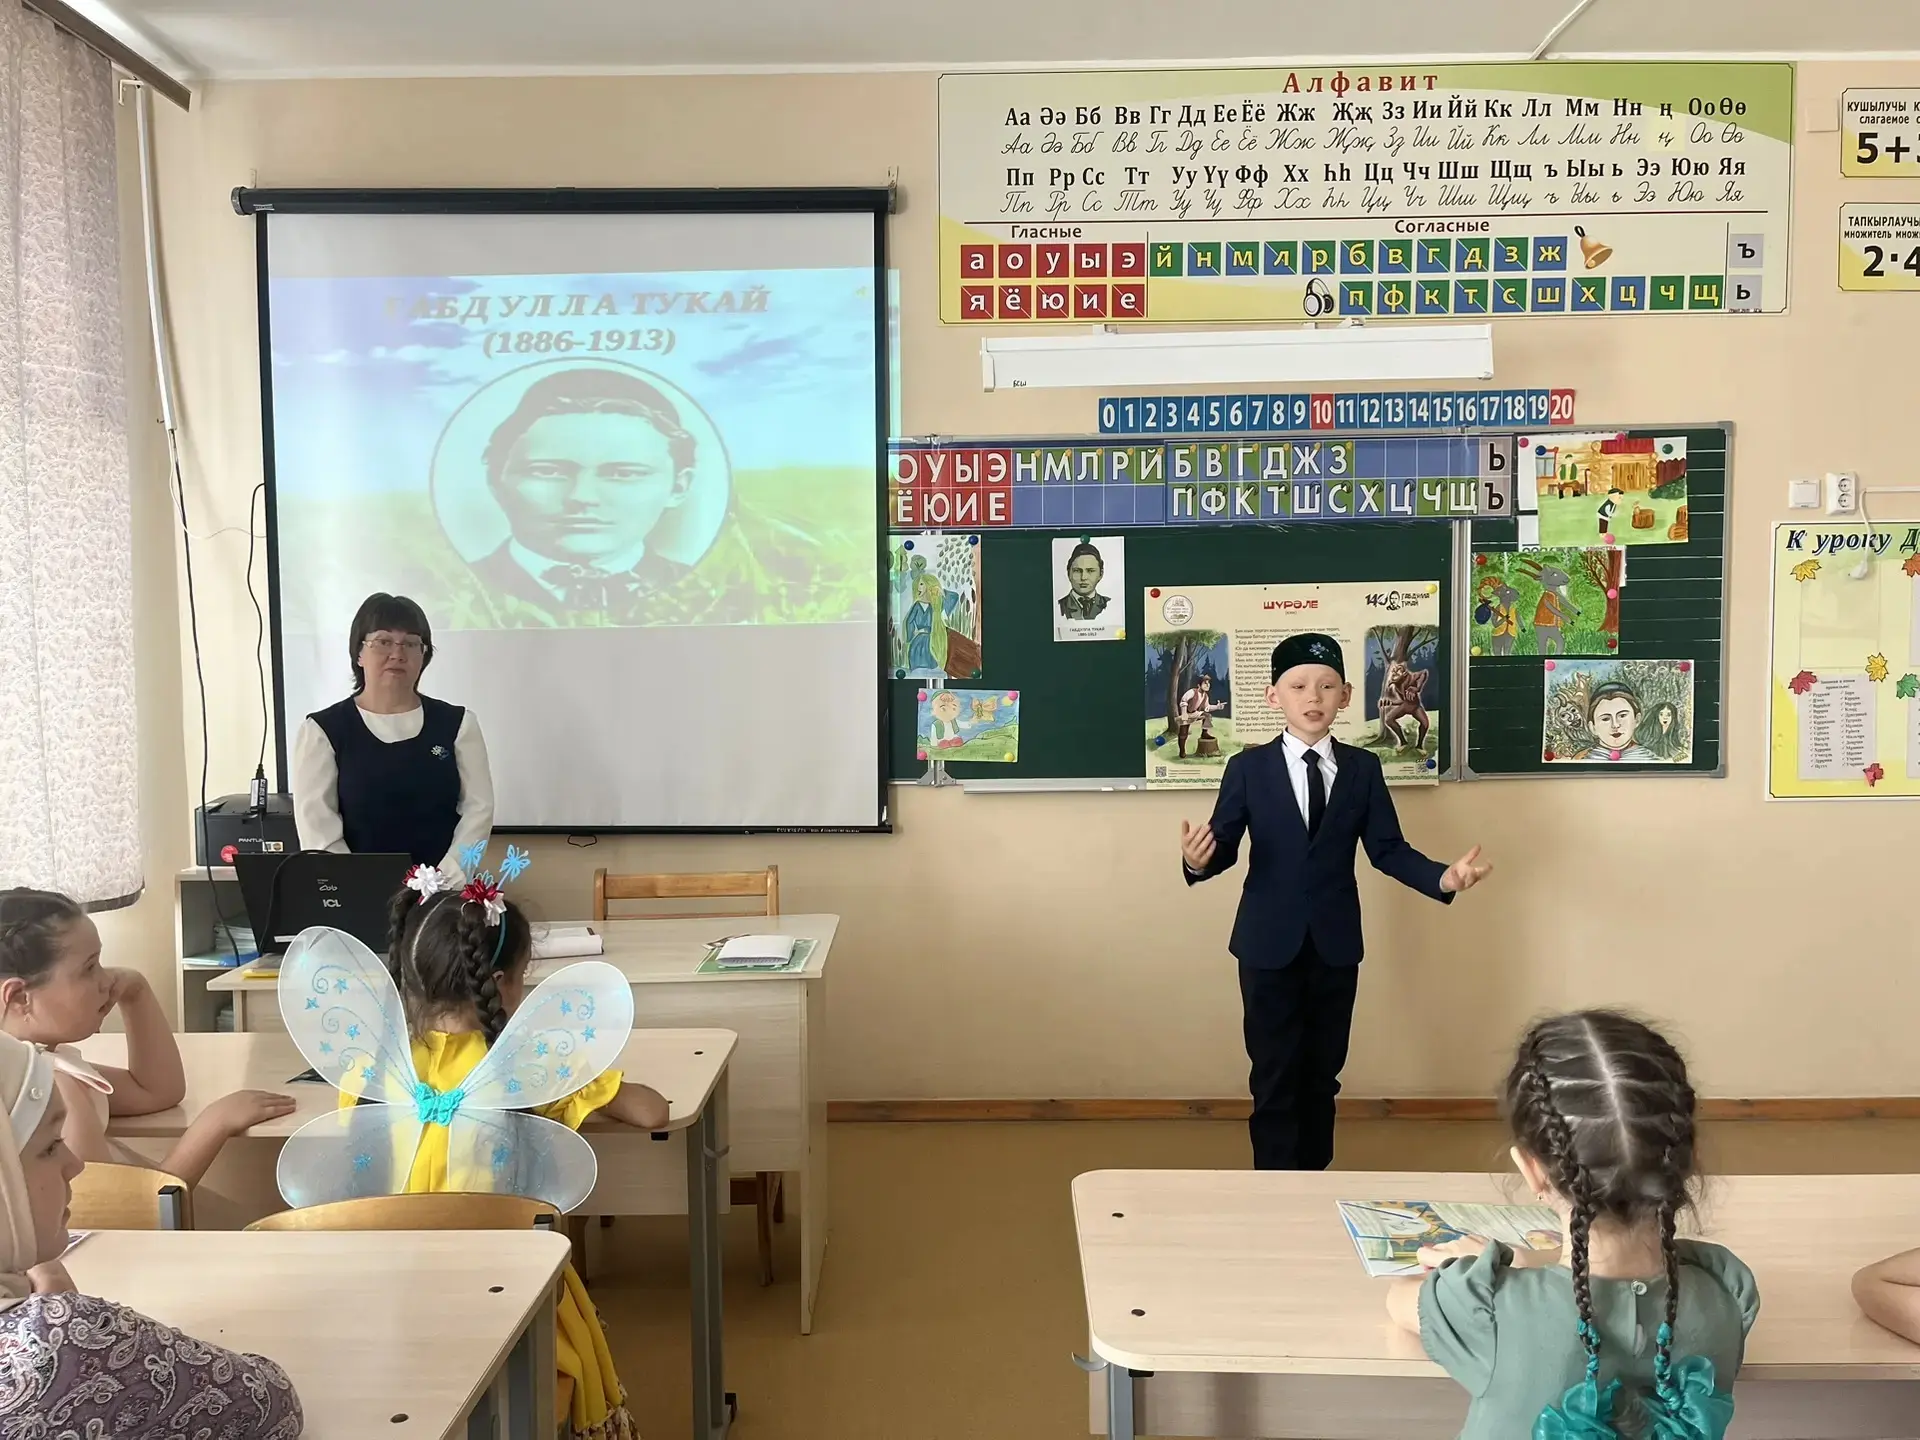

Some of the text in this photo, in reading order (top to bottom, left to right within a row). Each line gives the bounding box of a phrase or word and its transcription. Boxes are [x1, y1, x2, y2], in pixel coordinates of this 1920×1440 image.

[1282, 71, 1438, 98] Алфавит
[1005, 108, 1030, 125] Аа
[1040, 108, 1065, 125] Әә
[1076, 106, 1100, 124] Бб
[1115, 107, 1140, 124] Вв
[1150, 106, 1171, 123] Гг
[1178, 105, 1206, 127] Дд
[1214, 105, 1237, 122] Ее
[1242, 100, 1265, 122] Ёё
[1277, 104, 1315, 121] Жж
[1333, 103, 1372, 124] Җҗ
[1383, 102, 1404, 119] Зз
[1413, 101, 1442, 118] Ии
[1448, 95, 1477, 118] Йй
[1485, 100, 1512, 117] Кк
[1522, 99, 1551, 117] Лл
[1566, 99, 1599, 116] Мм
[1614, 98, 1642, 116] Нн
[1689, 98, 1715, 115] Оо
[1848, 102, 1906, 111] КУШЫЛУЧЫ
[1860, 116, 1909, 124] слагаемое
[1007, 169, 1034, 185] Пп
[1050, 169, 1074, 191] Рр
[1083, 168, 1104, 185] Сс
[1125, 167, 1149, 184] Тт
[1172, 167, 1197, 189] Уу
[1236, 165, 1268, 188] Фф
[1284, 165, 1308, 182] Хх
[1365, 163, 1393, 185] Цц
[1403, 162, 1429, 180] Чч
[1438, 161, 1478, 179] Шш
[1491, 160, 1531, 182] Щщ
[1567, 159, 1604, 177] Ыы
[1637, 159, 1660, 176] Ээ
[1672, 158, 1709, 175] Юю
[1719, 158, 1745, 175] Яя
[1011, 225, 1082, 240] Гласные
[1395, 218, 1491, 235] Согласные
[970, 253, 984, 270] а
[1046, 251, 1061, 275] у
[1081, 252, 1100, 269] ы
[1122, 251, 1135, 268] э
[1157, 246, 1172, 267] й
[1196, 250, 1212, 266] н
[1233, 250, 1253, 266] м
[1273, 249, 1290, 266] л
[1312, 248, 1328, 272] р
[1350, 242, 1366, 265] б
[1388, 248, 1403, 264] в
[1428, 247, 1440, 263] г
[1464, 247, 1482, 269] д
[1504, 246, 1518, 263] з
[1539, 245, 1561, 262] ж
[631, 284, 772, 316] ТУКАЙ
[969, 293, 985, 311] я
[1006, 288, 1021, 310] ё
[1042, 292, 1065, 310] ю
[1083, 292, 1098, 309] и
[1121, 291, 1135, 309] е
[1349, 289, 1363, 306] п
[1384, 284, 1404, 311] ф
[1425, 289, 1440, 305] к
[1465, 288, 1478, 304] т
[1538, 287, 1560, 303] ш
[1619, 286, 1636, 307] ц
[1659, 285, 1674, 300] ч
[1694, 284, 1719, 305] щ
[483, 328, 676, 359] (1886-1913)
[1103, 394, 1572, 428] 0 1 2 3 4 5 6 7 8 9 10 11 12 13 14 15 16 17 18 19 20
[925, 453, 946, 483] У
[956, 454, 978, 482] Ы
[987, 453, 1007, 482] Э
[1016, 453, 1037, 481] Н
[1043, 451, 1071, 482] М
[1077, 451, 1099, 481] Л
[1112, 451, 1129, 481] Р
[1141, 448, 1163, 480] Й
[1175, 449, 1192, 477] Б
[1206, 447, 1223, 478] В
[1238, 447, 1253, 476] Г
[1263, 447, 1288, 480] Д
[1293, 446, 1321, 475] Ж
[897, 489, 913, 522] Ё
[923, 493, 950, 522] Ю
[956, 492, 977, 521] И
[990, 492, 1006, 521] Е
[1201, 486, 1226, 516] Ф
[1235, 486, 1255, 516] К
[1267, 486, 1285, 515] Т
[1293, 485, 1321, 514] Ш
[1390, 483, 1412, 514] Ц
[1423, 483, 1441, 511] Ч
[1450, 482, 1478, 514] Щ
[1786, 530, 1806, 550] К
[1812, 533, 1892, 556] уроку
[322, 899, 341, 908] ICL
